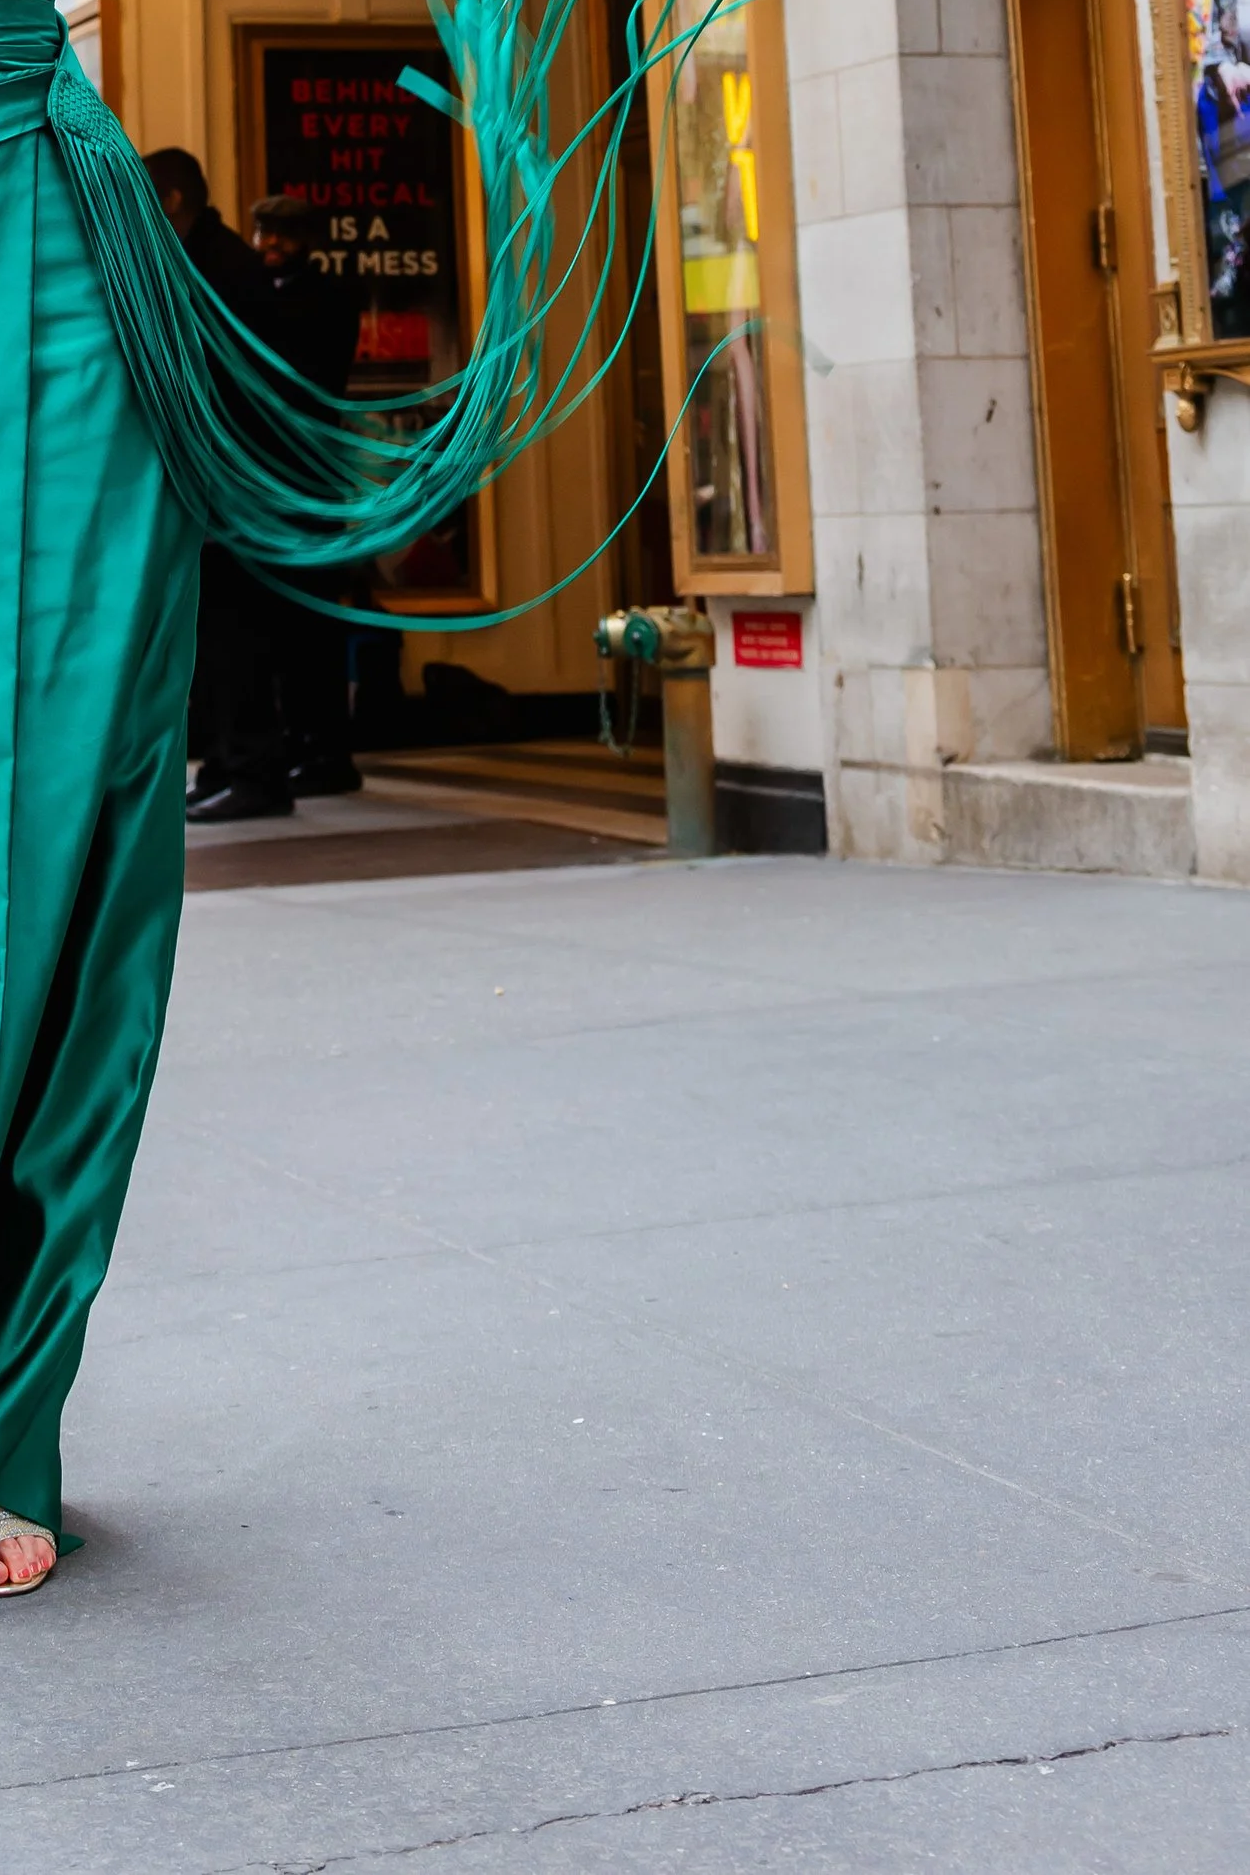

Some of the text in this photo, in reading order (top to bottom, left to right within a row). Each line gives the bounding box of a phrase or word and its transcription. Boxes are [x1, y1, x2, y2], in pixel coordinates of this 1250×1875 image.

[301, 113, 410, 138] EVERY
[331, 148, 384, 171] HIT
[283, 182, 435, 207] MUSICAL
[330, 216, 390, 241] IS A
[308, 250, 438, 275] OT MESS
